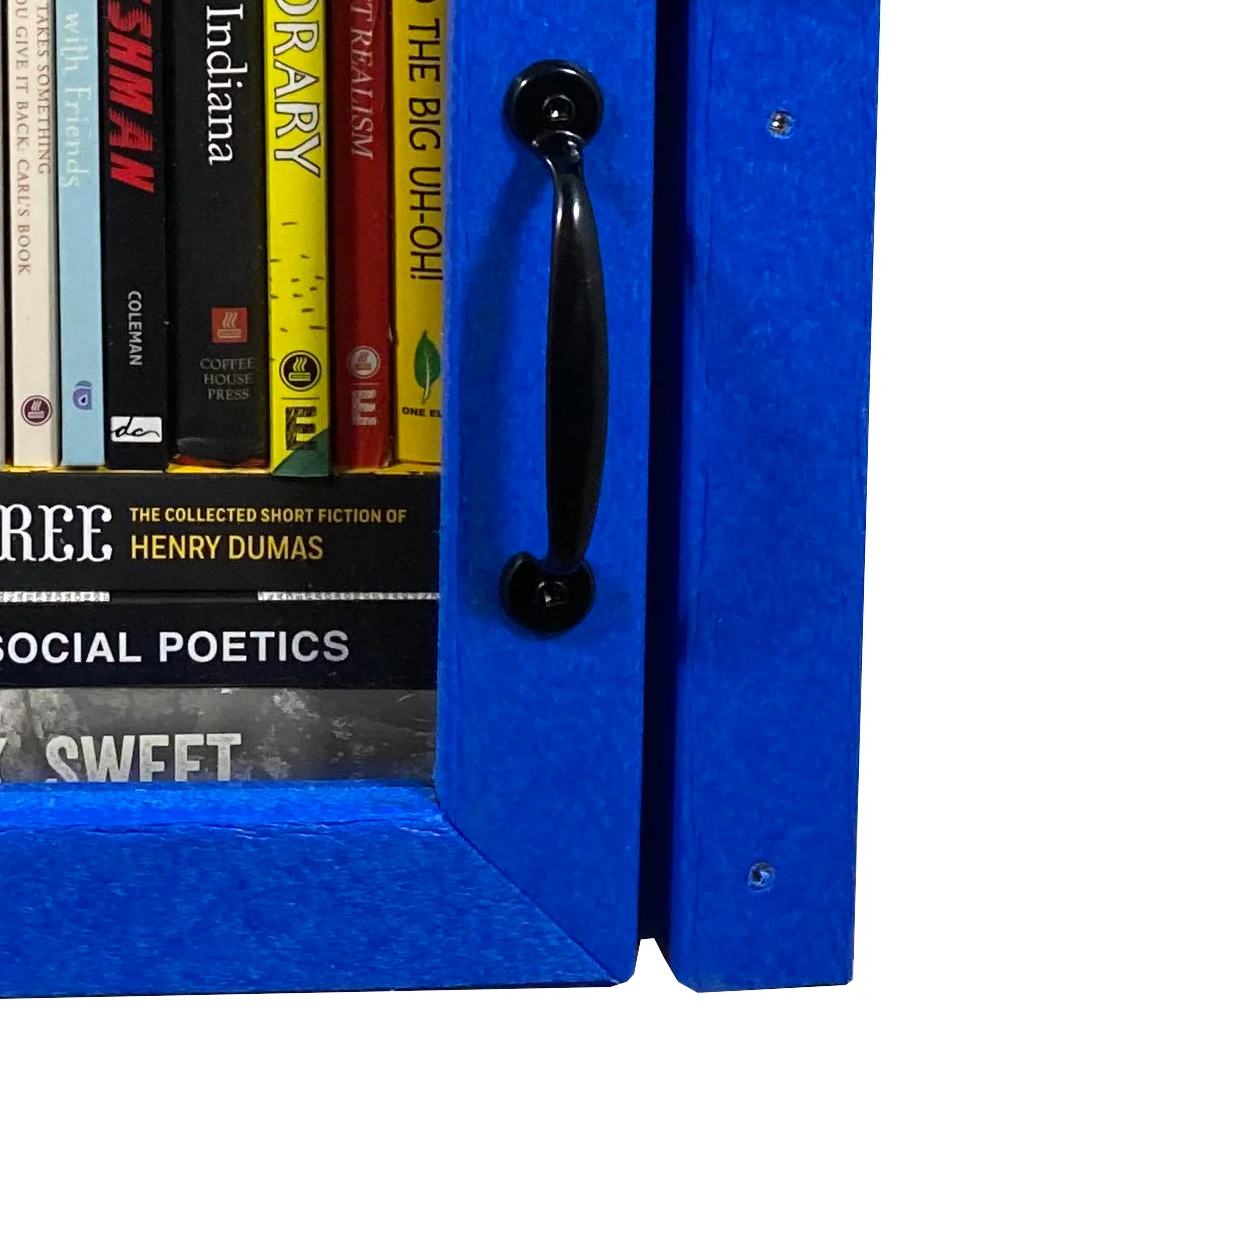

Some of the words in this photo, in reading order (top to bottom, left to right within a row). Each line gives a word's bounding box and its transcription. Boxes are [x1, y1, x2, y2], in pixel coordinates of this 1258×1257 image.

[15, 27, 29, 70] GIVE
[36, 2, 50, 61] TAKES
[59, 12, 90, 75] with
[408, 18, 441, 82] THE
[16, 74, 29, 94] IT
[206, 3, 248, 166] Indiana
[351, 28, 375, 159] REALISM
[37, 63, 51, 175] SOMETHING
[61, 84, 92, 188] Friends
[408, 97, 441, 151] BIG
[17, 159, 31, 218] CARL'S
[18, 224, 31, 274] BOOK
[409, 166, 443, 281] UH-OH!
[127, 290, 142, 367] COLEMAN
[200, 357, 255, 371] COFFEE
[203, 372, 253, 386] HOUSE
[207, 387, 250, 401] PRESS
[401, 406, 426, 417] ONE
[429, 408, 443, 418] EL
[129, 507, 161, 523] THE
[165, 507, 257, 523] COLLECTED
[260, 507, 313, 523] SHORT
[318, 508, 382, 524] FICTION
[385, 509, 408, 524] OF
[131, 534, 221, 560] HENRY
[228, 534, 324, 561] DUMAS
[158, 629, 350, 663] POETICS
[45, 732, 242, 783] SWEET
